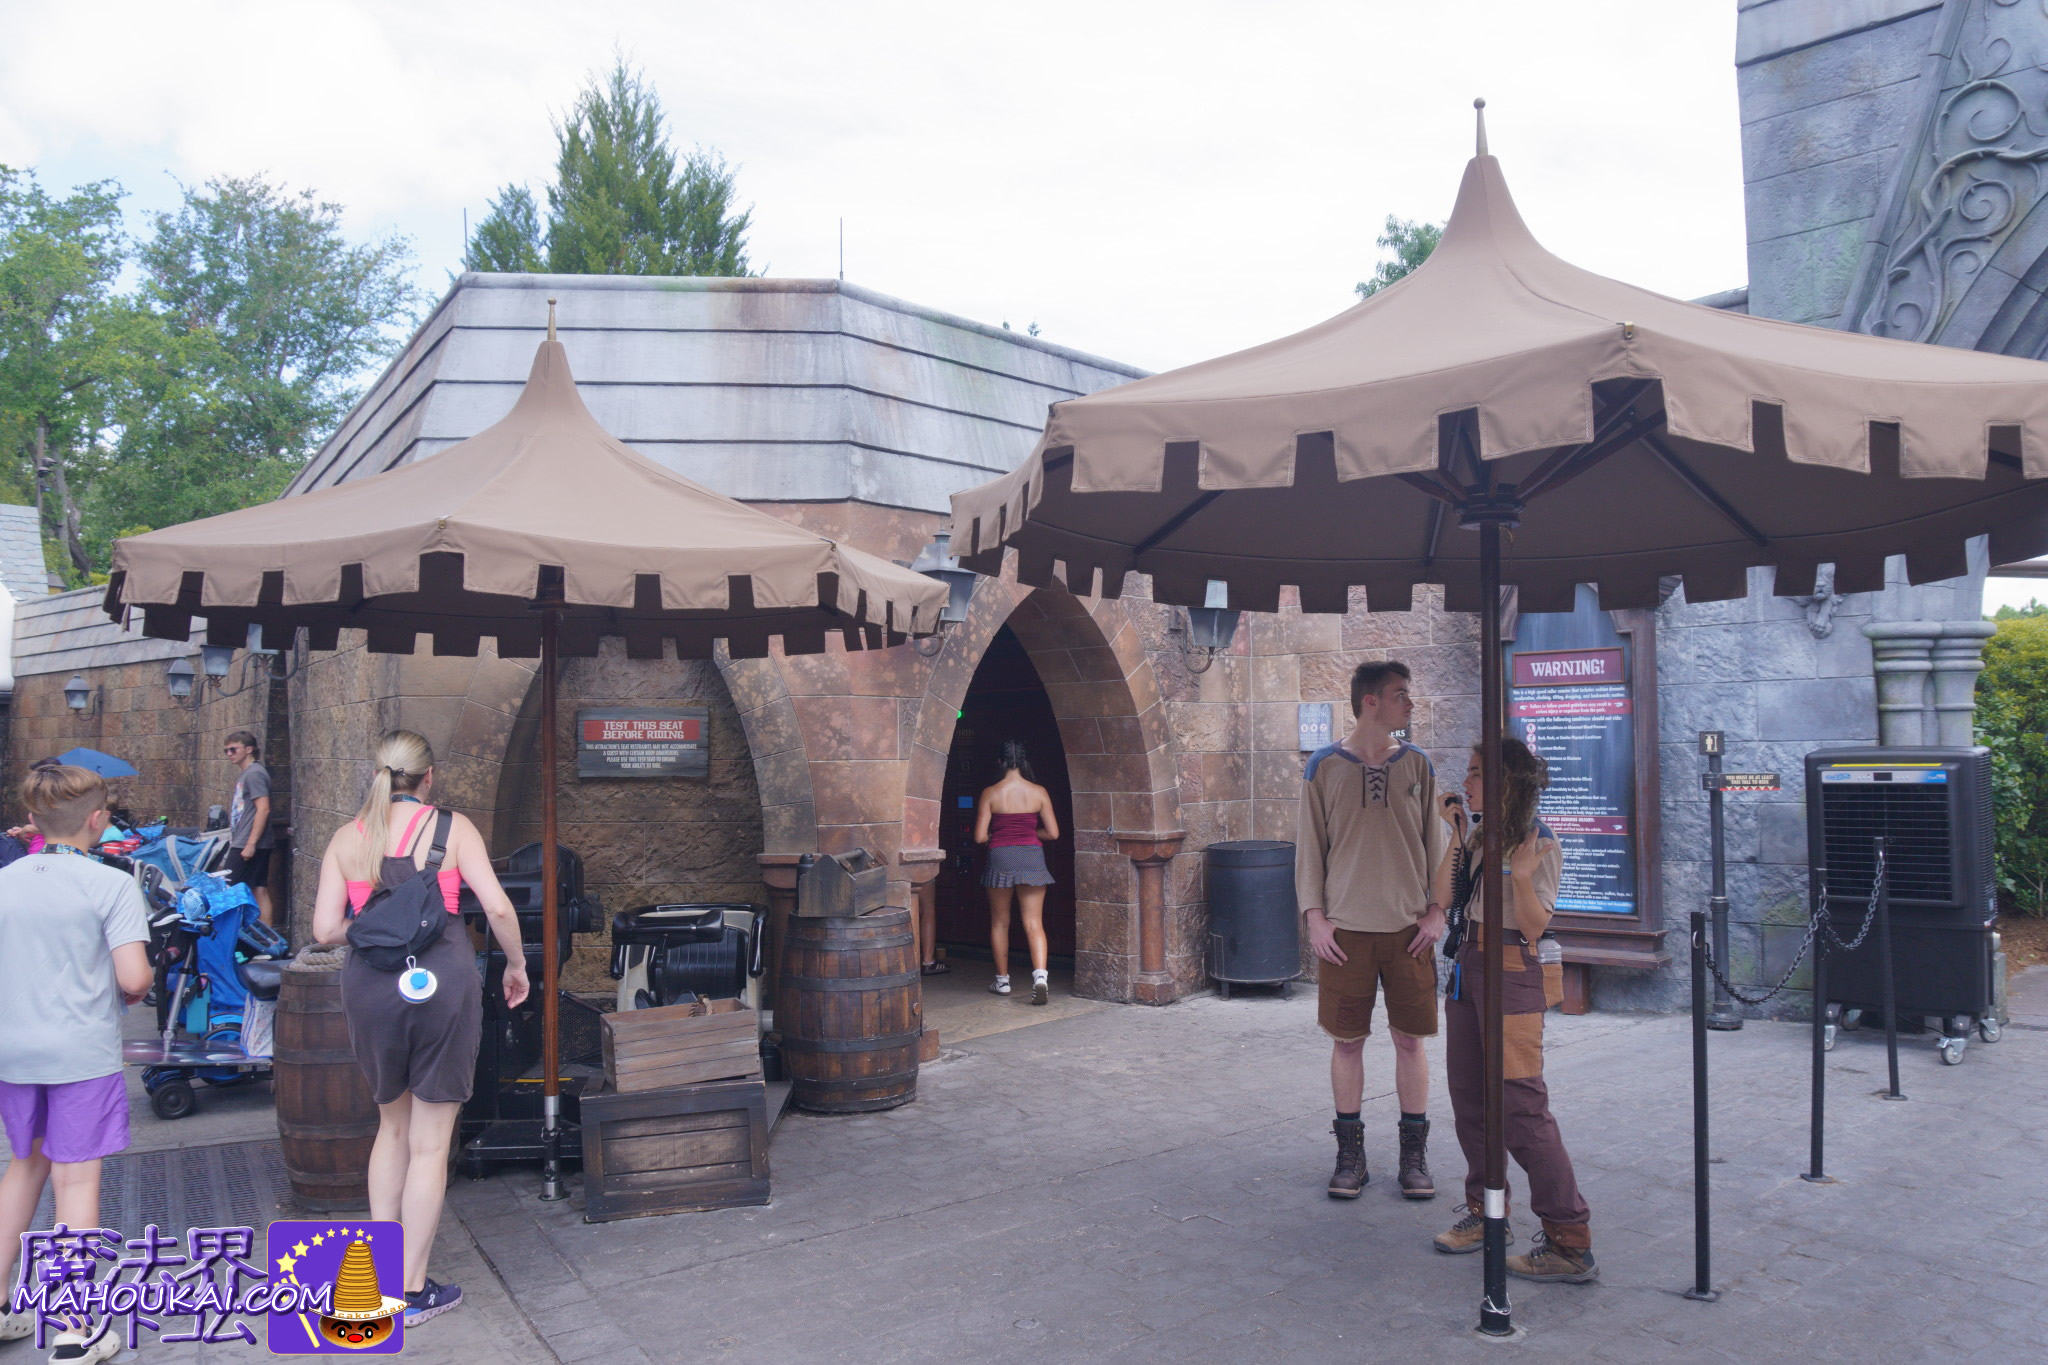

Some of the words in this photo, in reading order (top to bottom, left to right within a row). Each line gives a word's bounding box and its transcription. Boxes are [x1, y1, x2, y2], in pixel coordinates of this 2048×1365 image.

[1530, 659, 1605, 677] WARNING!
[604, 721, 629, 730] TEST
[632, 721, 656, 730] THIS
[659, 721, 684, 730] SEAT
[602, 731, 644, 739] BEFORE
[646, 731, 684, 739] RIDING
